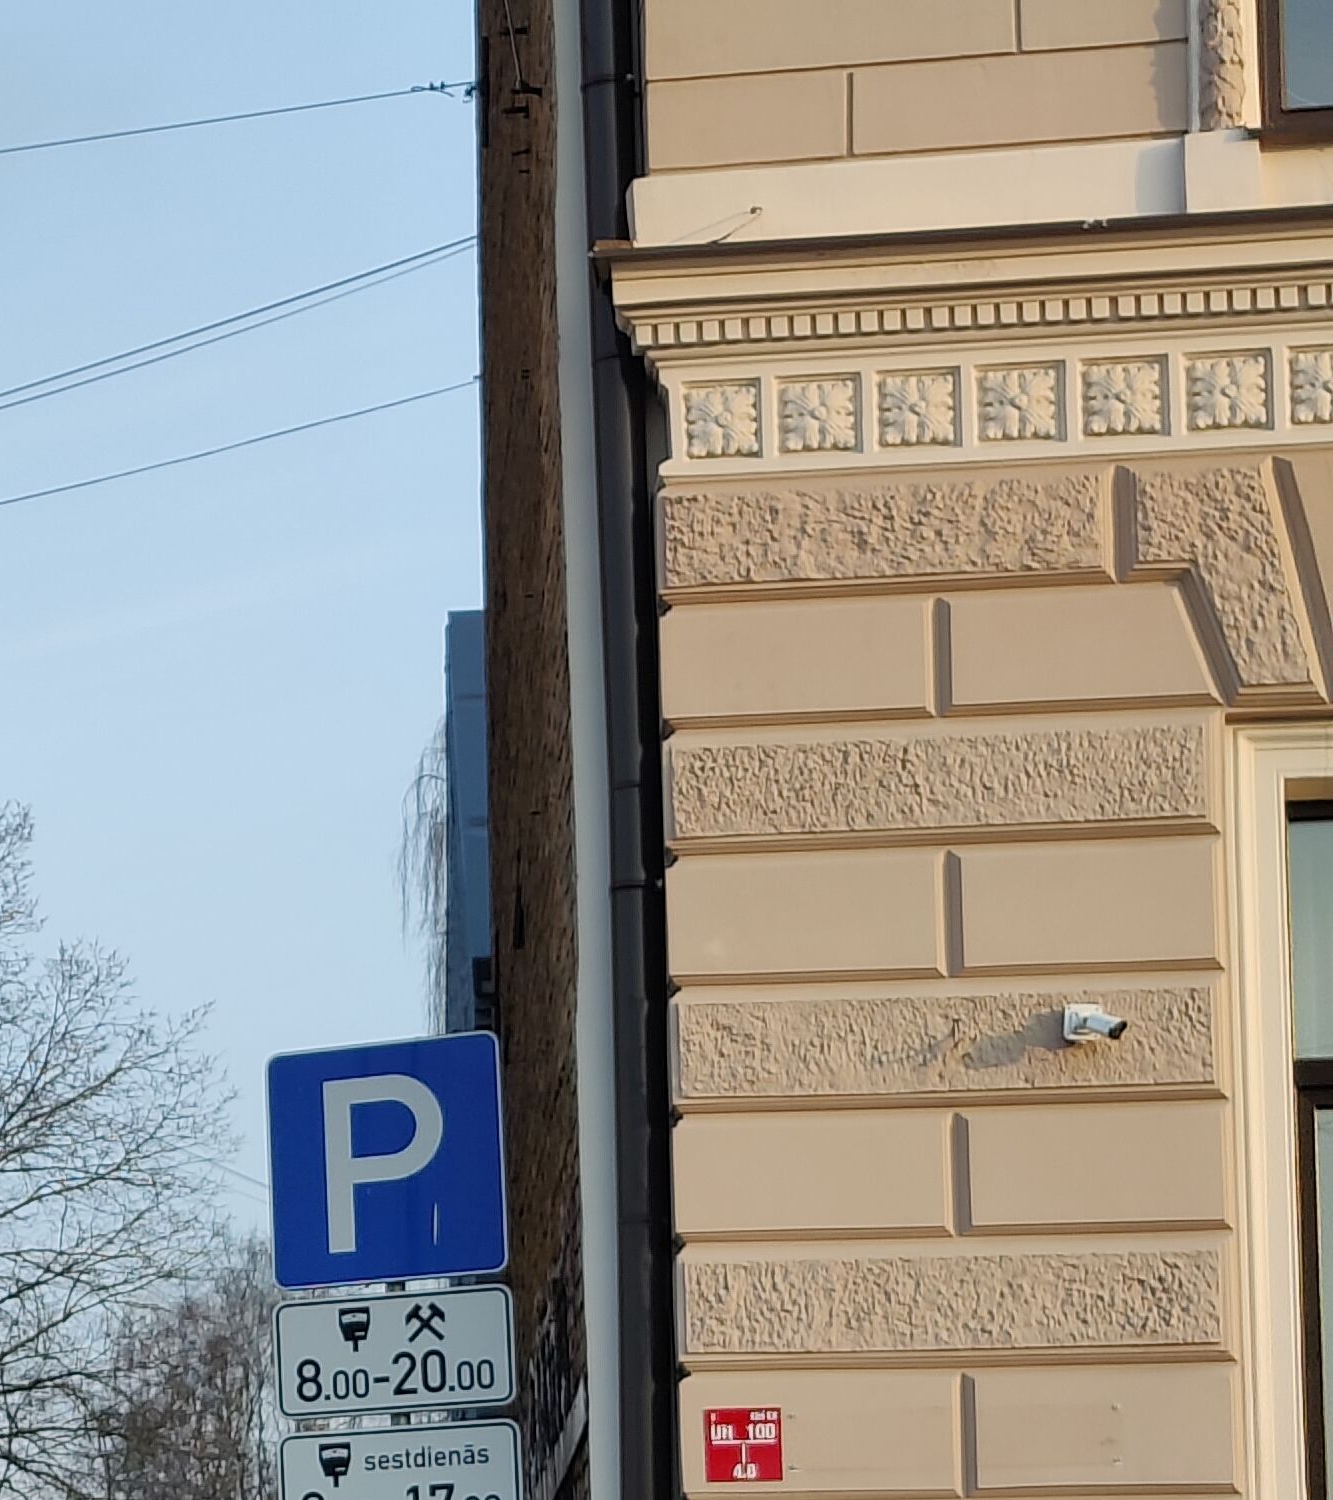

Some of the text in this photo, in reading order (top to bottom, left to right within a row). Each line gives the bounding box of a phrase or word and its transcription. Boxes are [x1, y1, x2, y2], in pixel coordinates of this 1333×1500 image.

[322, 1073, 444, 1255] P
[296, 1349, 495, 1402] 8.00-20.00
[364, 1444, 490, 1471] sestdienās
